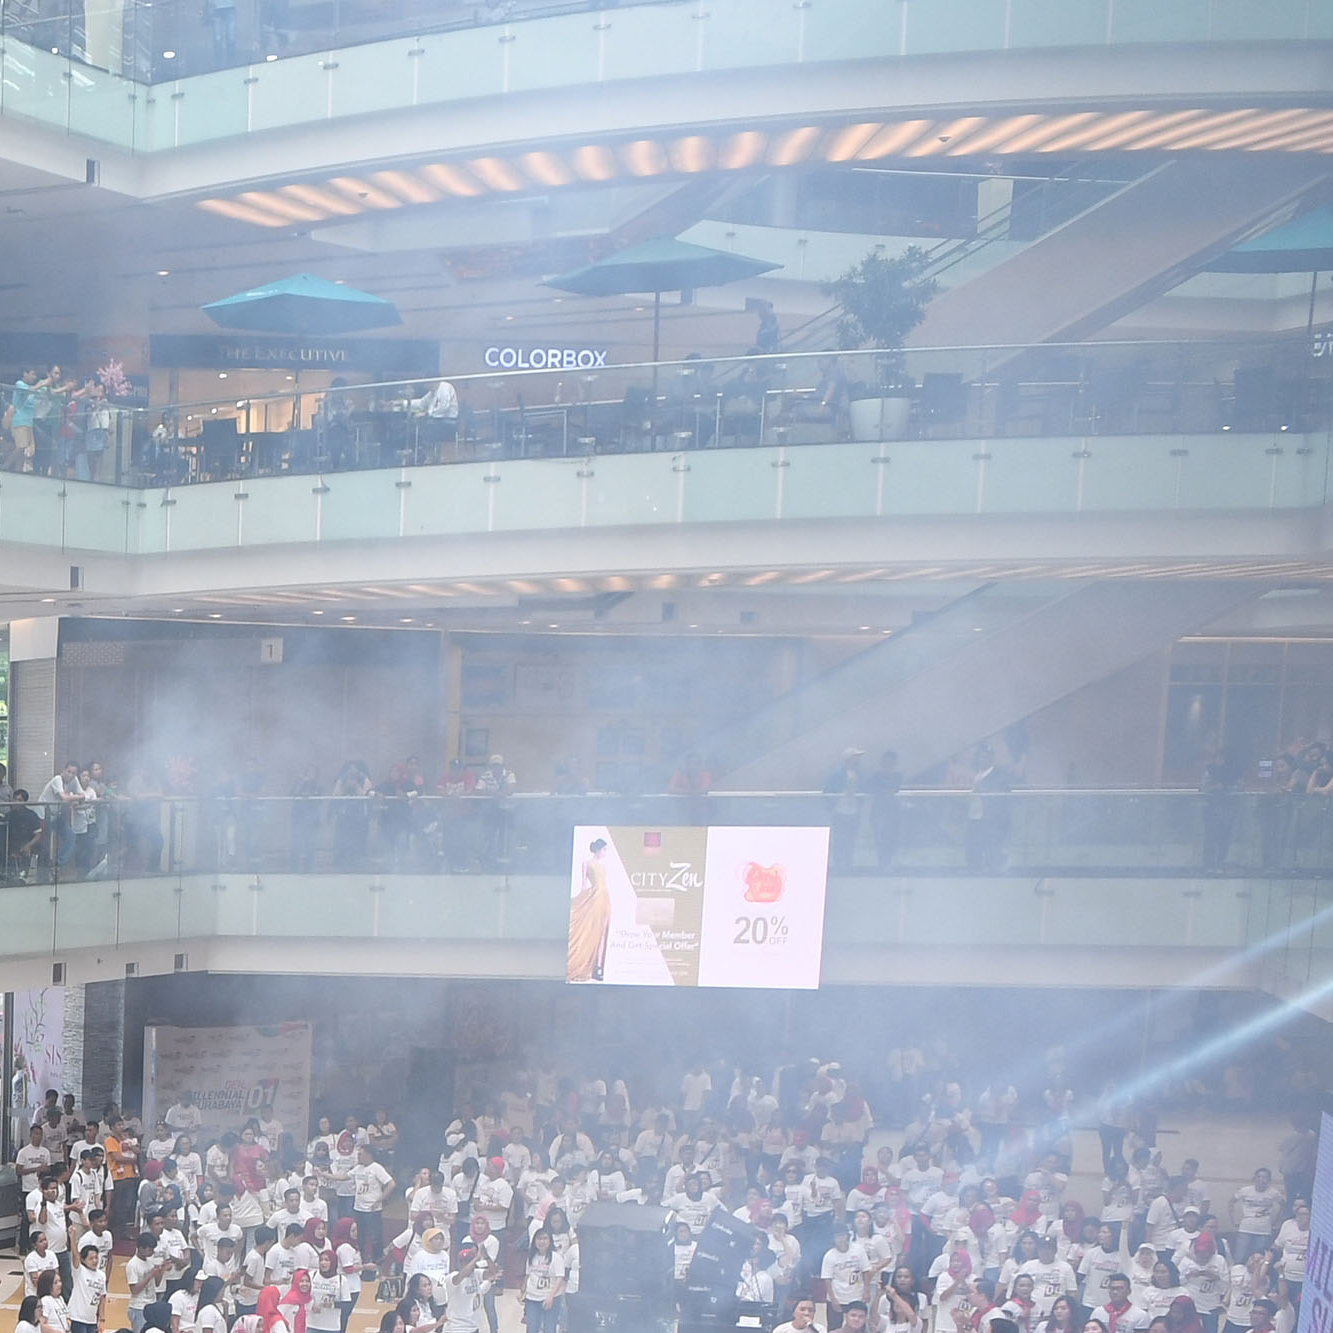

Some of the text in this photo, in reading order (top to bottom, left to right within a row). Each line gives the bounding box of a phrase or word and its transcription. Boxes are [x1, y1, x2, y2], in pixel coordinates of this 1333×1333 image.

[484, 347, 608, 369] COLORBOX
[266, 644, 273, 659] 1
[661, 930, 695, 940] Member
[768, 937, 788, 945] OFF
